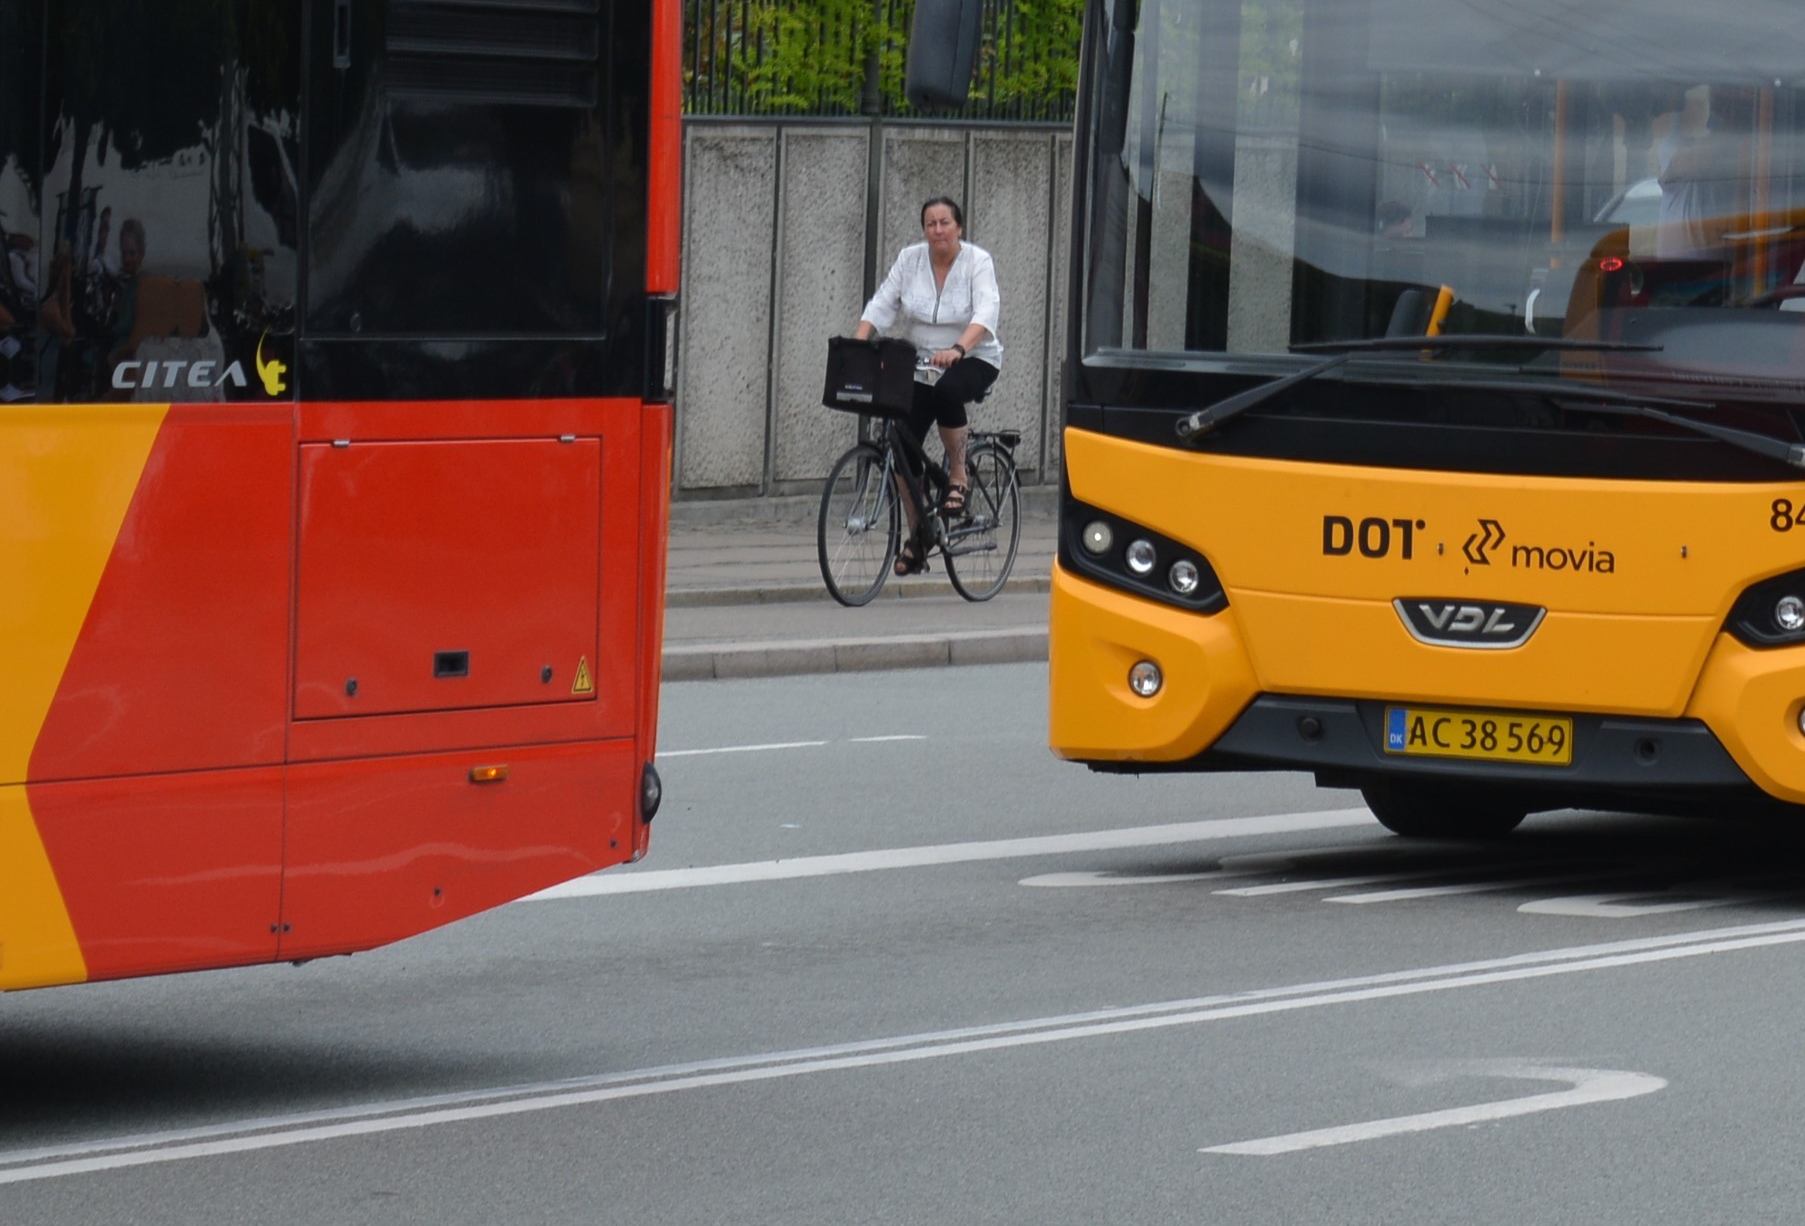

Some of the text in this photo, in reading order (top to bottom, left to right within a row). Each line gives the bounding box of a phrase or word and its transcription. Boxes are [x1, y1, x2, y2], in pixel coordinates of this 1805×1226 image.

[111, 359, 248, 390] CITEA
[1322, 514, 1426, 561] DOT
[1511, 541, 1616, 574] movia
[1418, 603, 1516, 634] VDL
[1390, 732, 1403, 745] DK
[1408, 715, 1566, 757] AC 38 569
